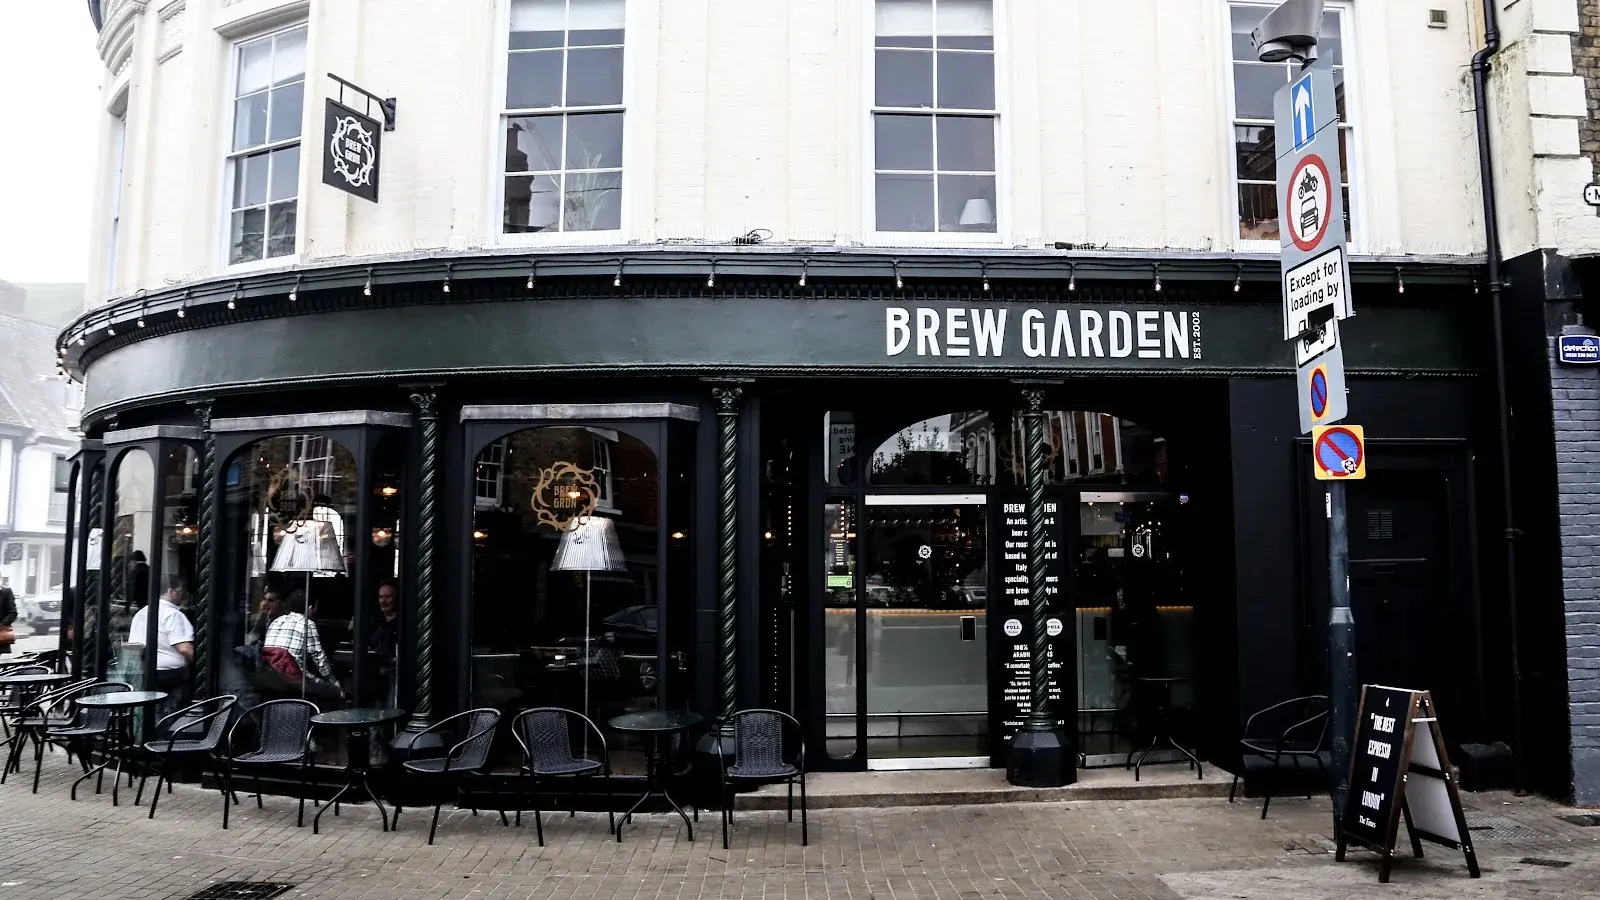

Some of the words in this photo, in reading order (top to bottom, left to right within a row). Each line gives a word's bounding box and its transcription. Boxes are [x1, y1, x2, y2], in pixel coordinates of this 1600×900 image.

[345, 137, 362, 153] BREW
[1290, 266, 1320, 292] Except
[1323, 262, 1337, 277] for
[1290, 288, 1324, 312] loading
[1326, 282, 1339, 297] by
[886, 307, 1007, 357] BREW
[1021, 308, 1190, 359] GARDEN
[554, 485, 578, 496] BREW
[553, 498, 577, 509] GRDN
[1004, 504, 1026, 513] BREW
[1004, 552, 1020, 560] based
[1015, 564, 1028, 573] Italy
[1382, 716, 1396, 733] BEST
[1367, 739, 1392, 760] ESPRESSO
[1370, 766, 1379, 783] IN
